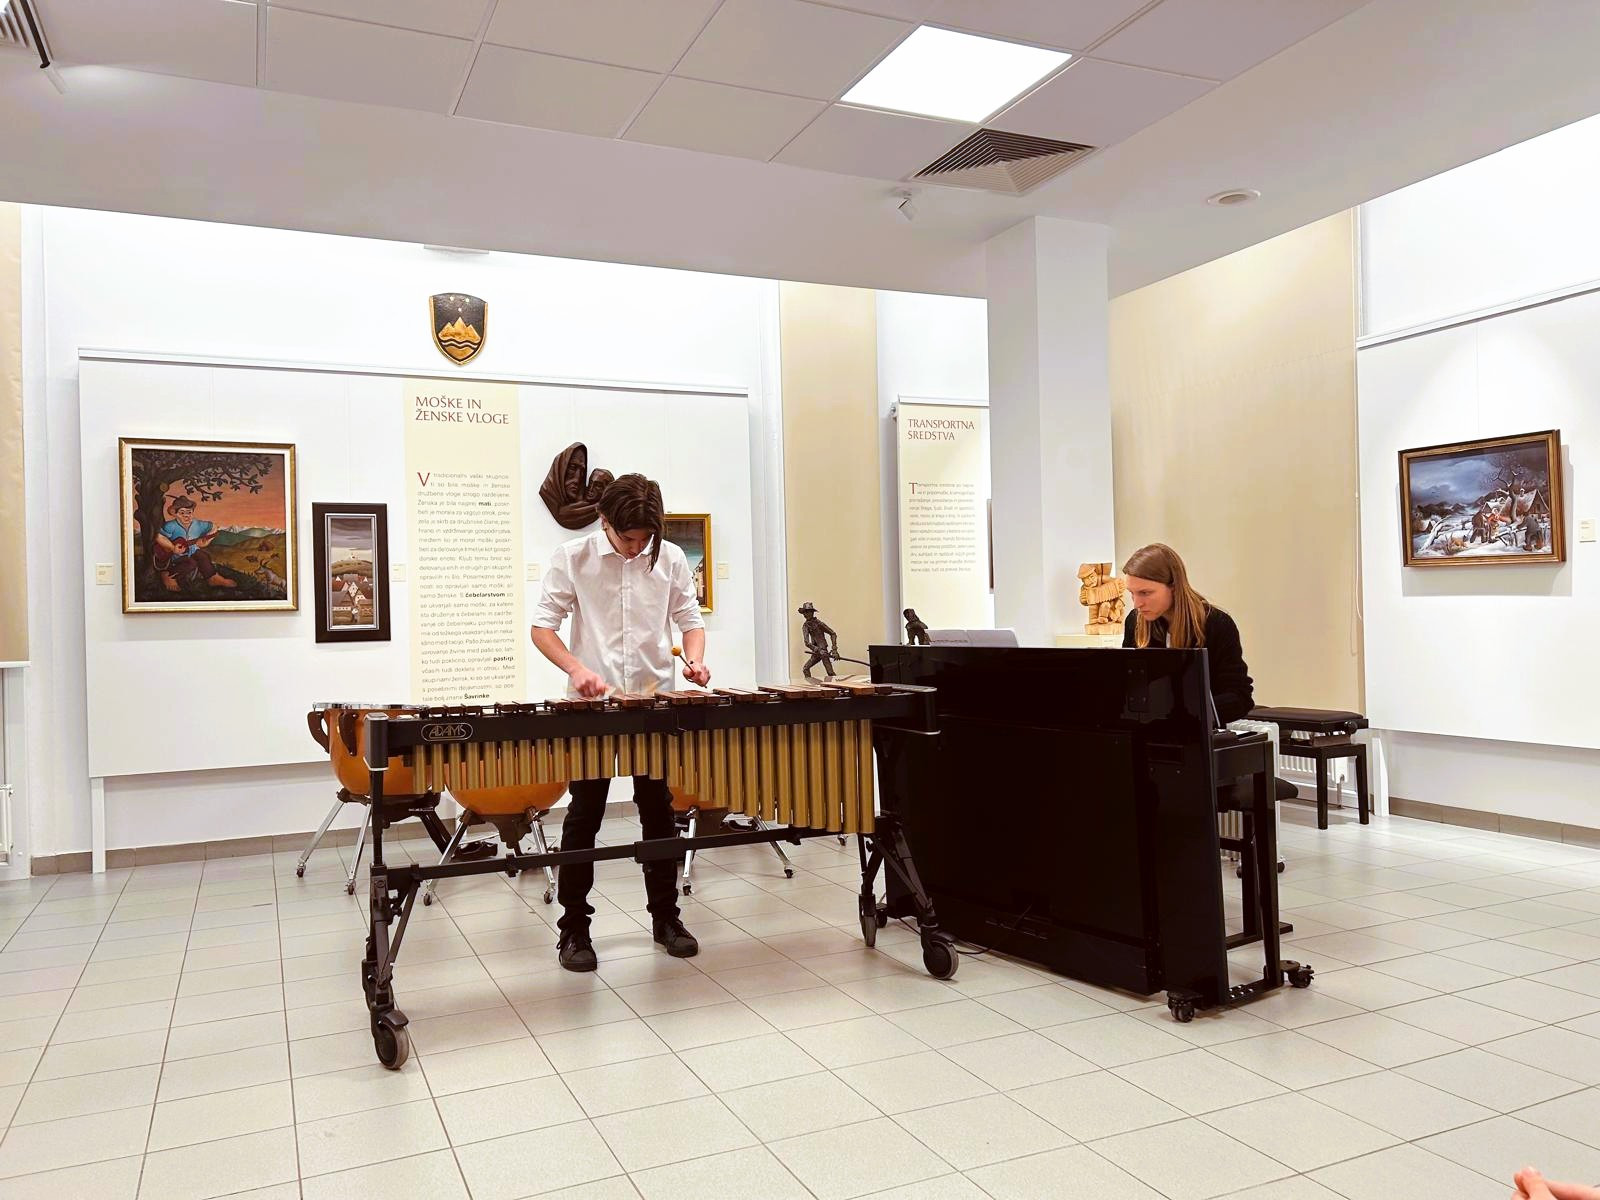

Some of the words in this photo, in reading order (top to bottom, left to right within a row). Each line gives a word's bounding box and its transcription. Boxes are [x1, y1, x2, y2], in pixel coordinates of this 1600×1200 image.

[415, 395, 463, 409] MOŠKE
[467, 399, 482, 409] IN
[415, 408, 463, 422] ŽENSKE
[466, 412, 509, 424] VLOGE
[907, 418, 975, 430] TRANSPORTNA
[907, 430, 955, 440] SREDSTVA
[417, 472, 430, 487] V
[429, 725, 466, 739] ADAMS
